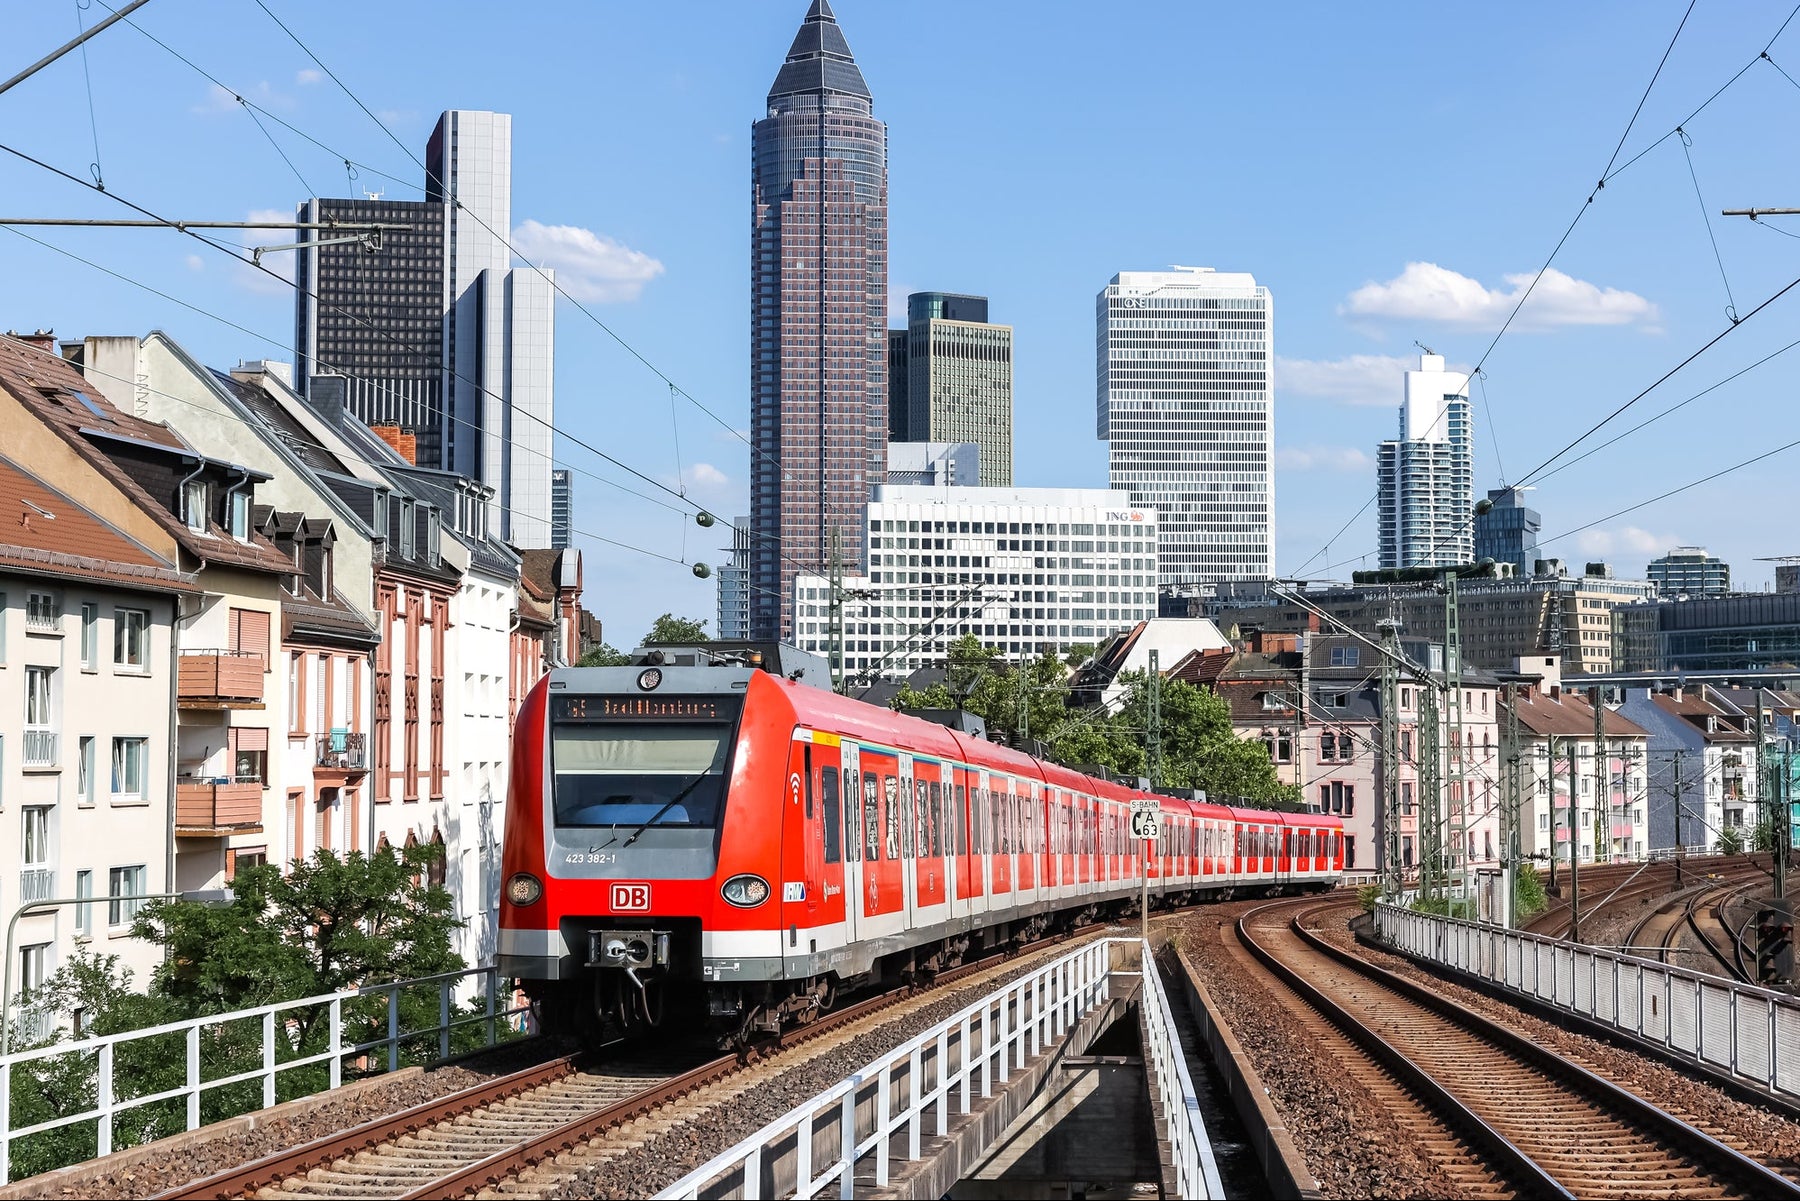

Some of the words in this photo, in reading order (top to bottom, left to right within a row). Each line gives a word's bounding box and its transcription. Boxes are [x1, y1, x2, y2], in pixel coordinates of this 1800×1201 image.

[1105, 511, 1129, 521] ING
[1146, 812, 1154, 823] A
[1142, 824, 1157, 836] 63
[565, 854, 584, 864] 423
[587, 854, 616, 864] 382-1
[614, 887, 646, 908] DB
